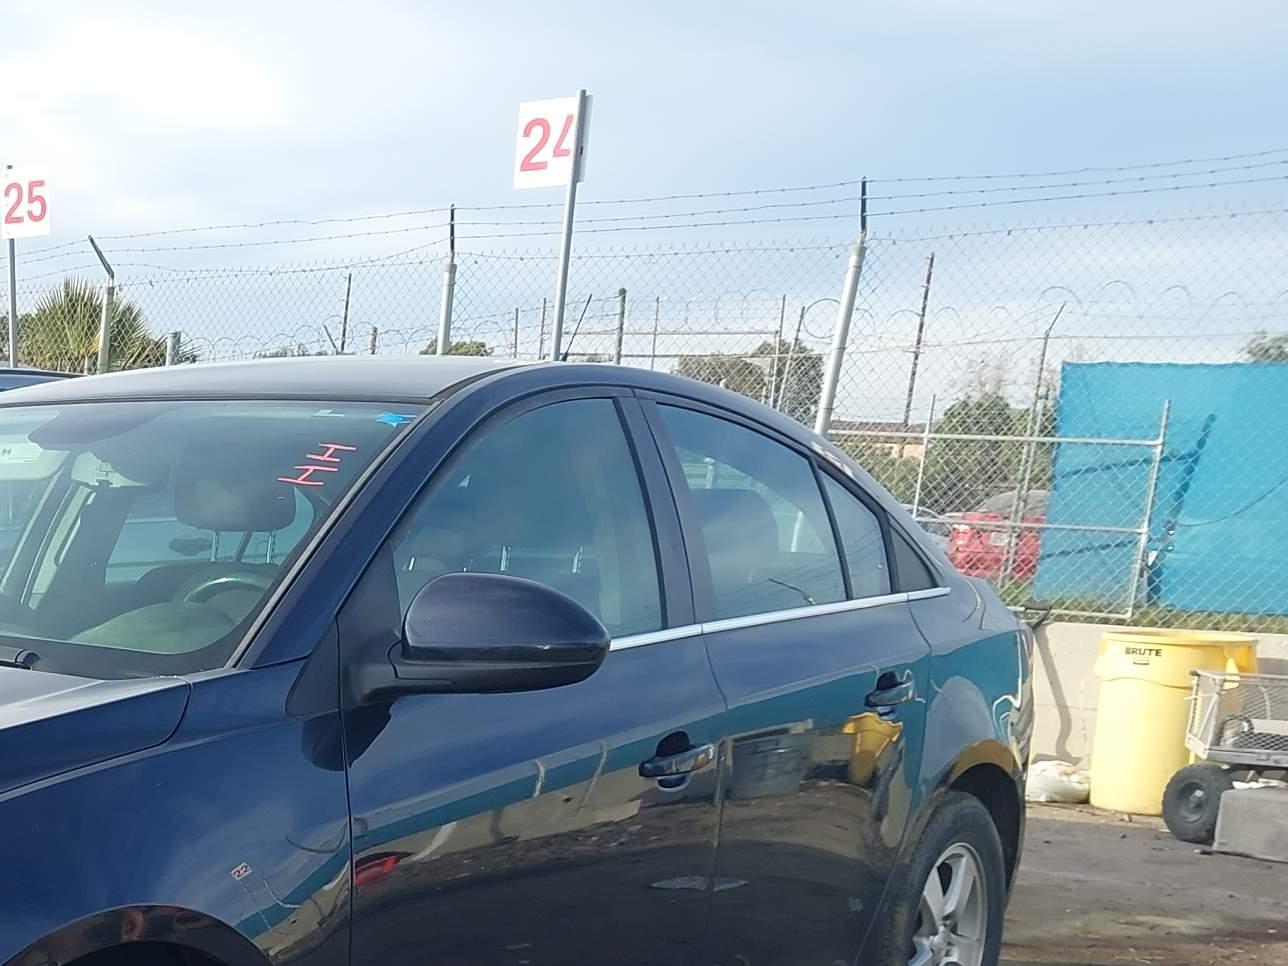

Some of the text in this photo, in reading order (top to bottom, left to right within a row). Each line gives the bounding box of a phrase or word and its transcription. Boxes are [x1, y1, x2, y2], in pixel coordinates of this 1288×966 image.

[519, 113, 574, 172] 24
[4, 179, 47, 224] 25
[1124, 647, 1163, 657] BRUTE
